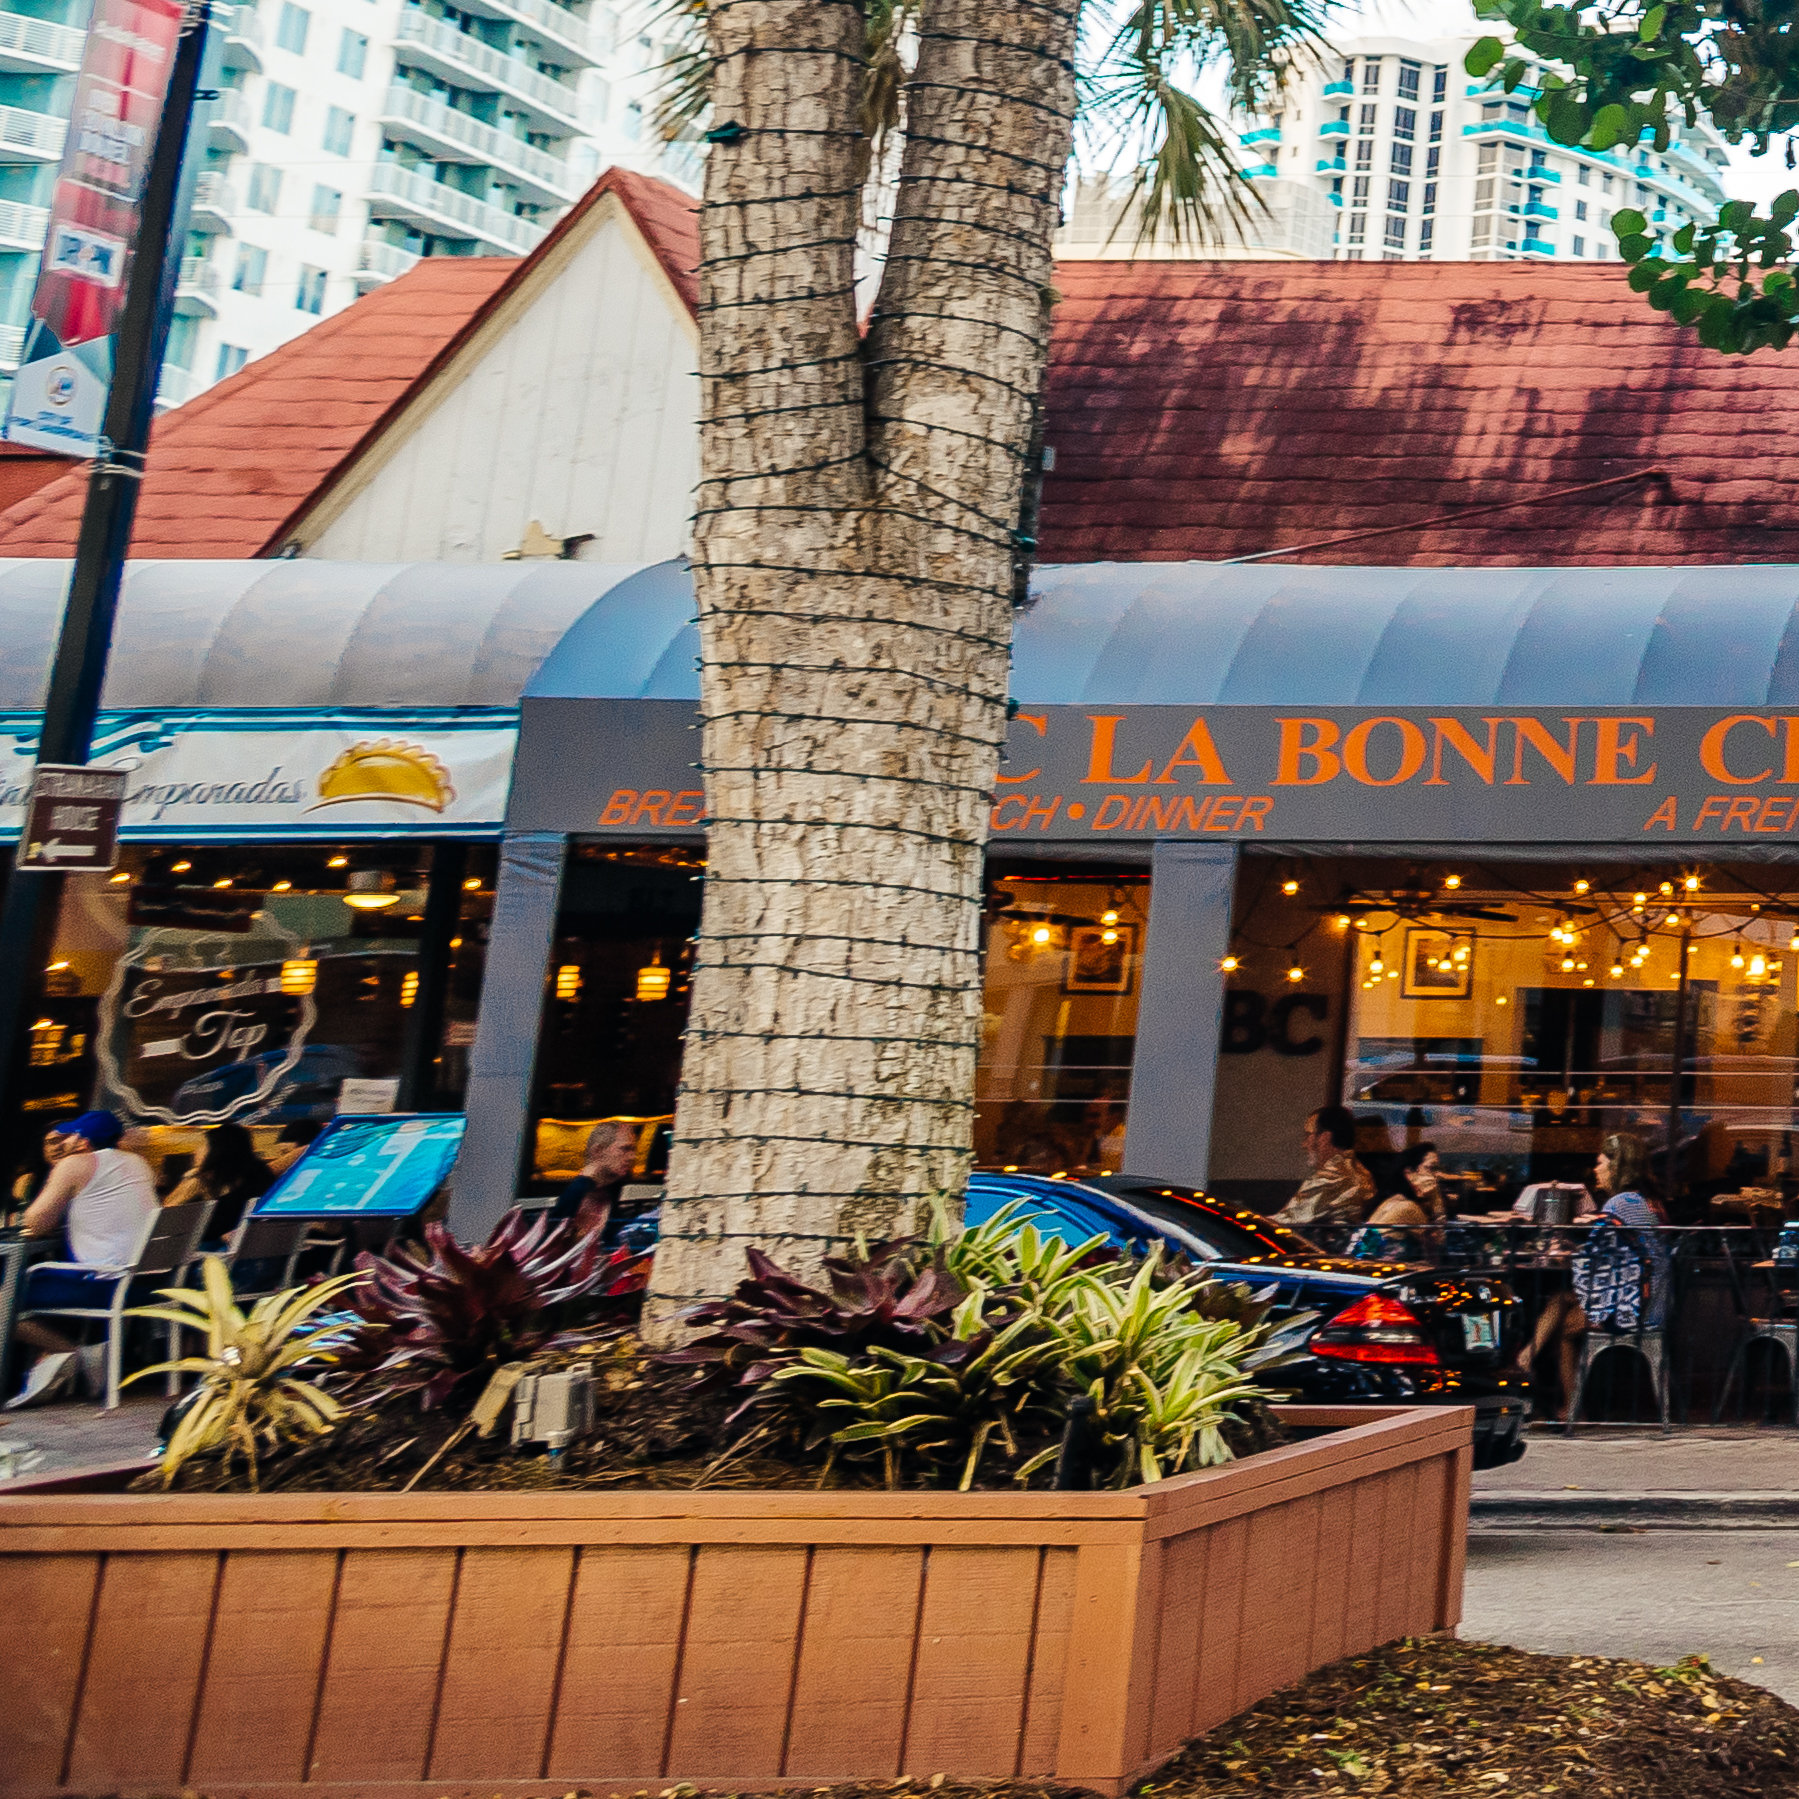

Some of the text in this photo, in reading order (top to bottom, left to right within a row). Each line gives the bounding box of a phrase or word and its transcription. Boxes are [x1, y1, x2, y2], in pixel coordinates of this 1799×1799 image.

[1079, 713, 1236, 786] LA
[1268, 715, 1659, 787] BONNE
[597, 789, 1276, 833] BRE CH DINNER
[1643, 795, 1678, 832] A
